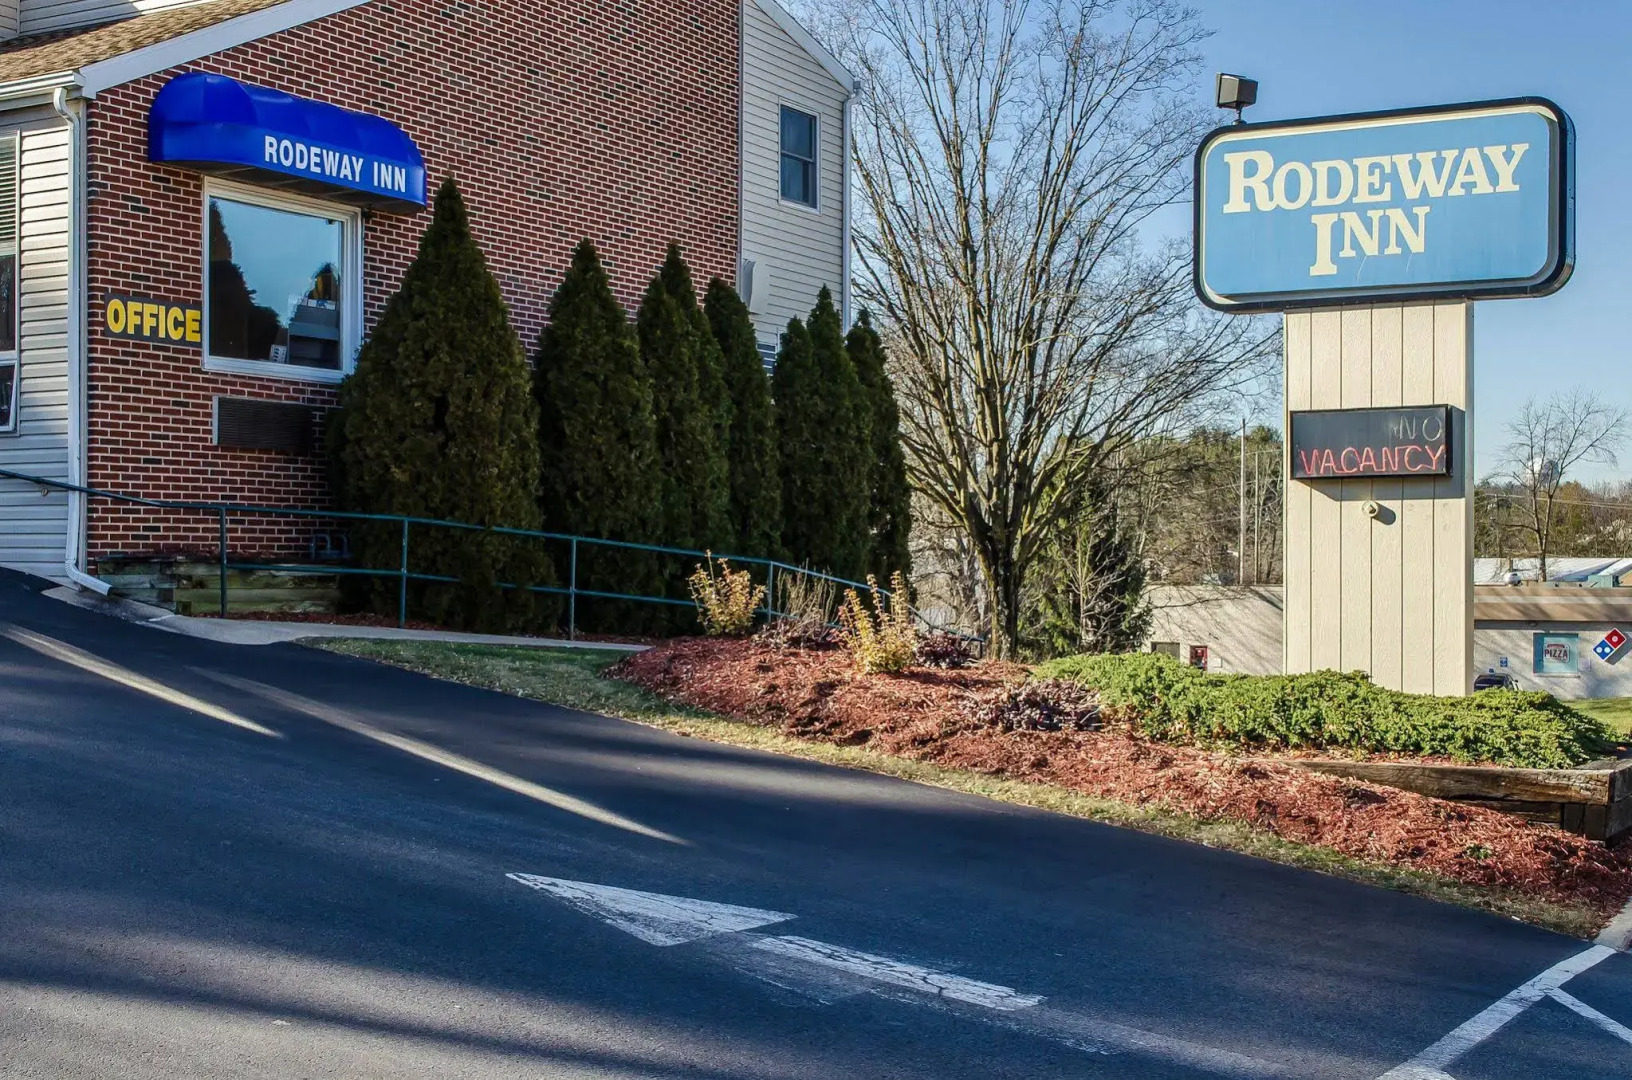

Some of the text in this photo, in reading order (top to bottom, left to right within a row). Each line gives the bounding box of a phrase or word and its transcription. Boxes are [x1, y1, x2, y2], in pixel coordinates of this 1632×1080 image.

[264, 135, 406, 193] RODEWAY INN
[1223, 143, 1529, 214] RODEWAY
[1309, 206, 1430, 277] INN
[106, 298, 201, 342] OFFICE
[1399, 415, 1442, 442] NO
[1301, 445, 1445, 475] VACANCY
[1544, 649, 1568, 658] PIZZA
